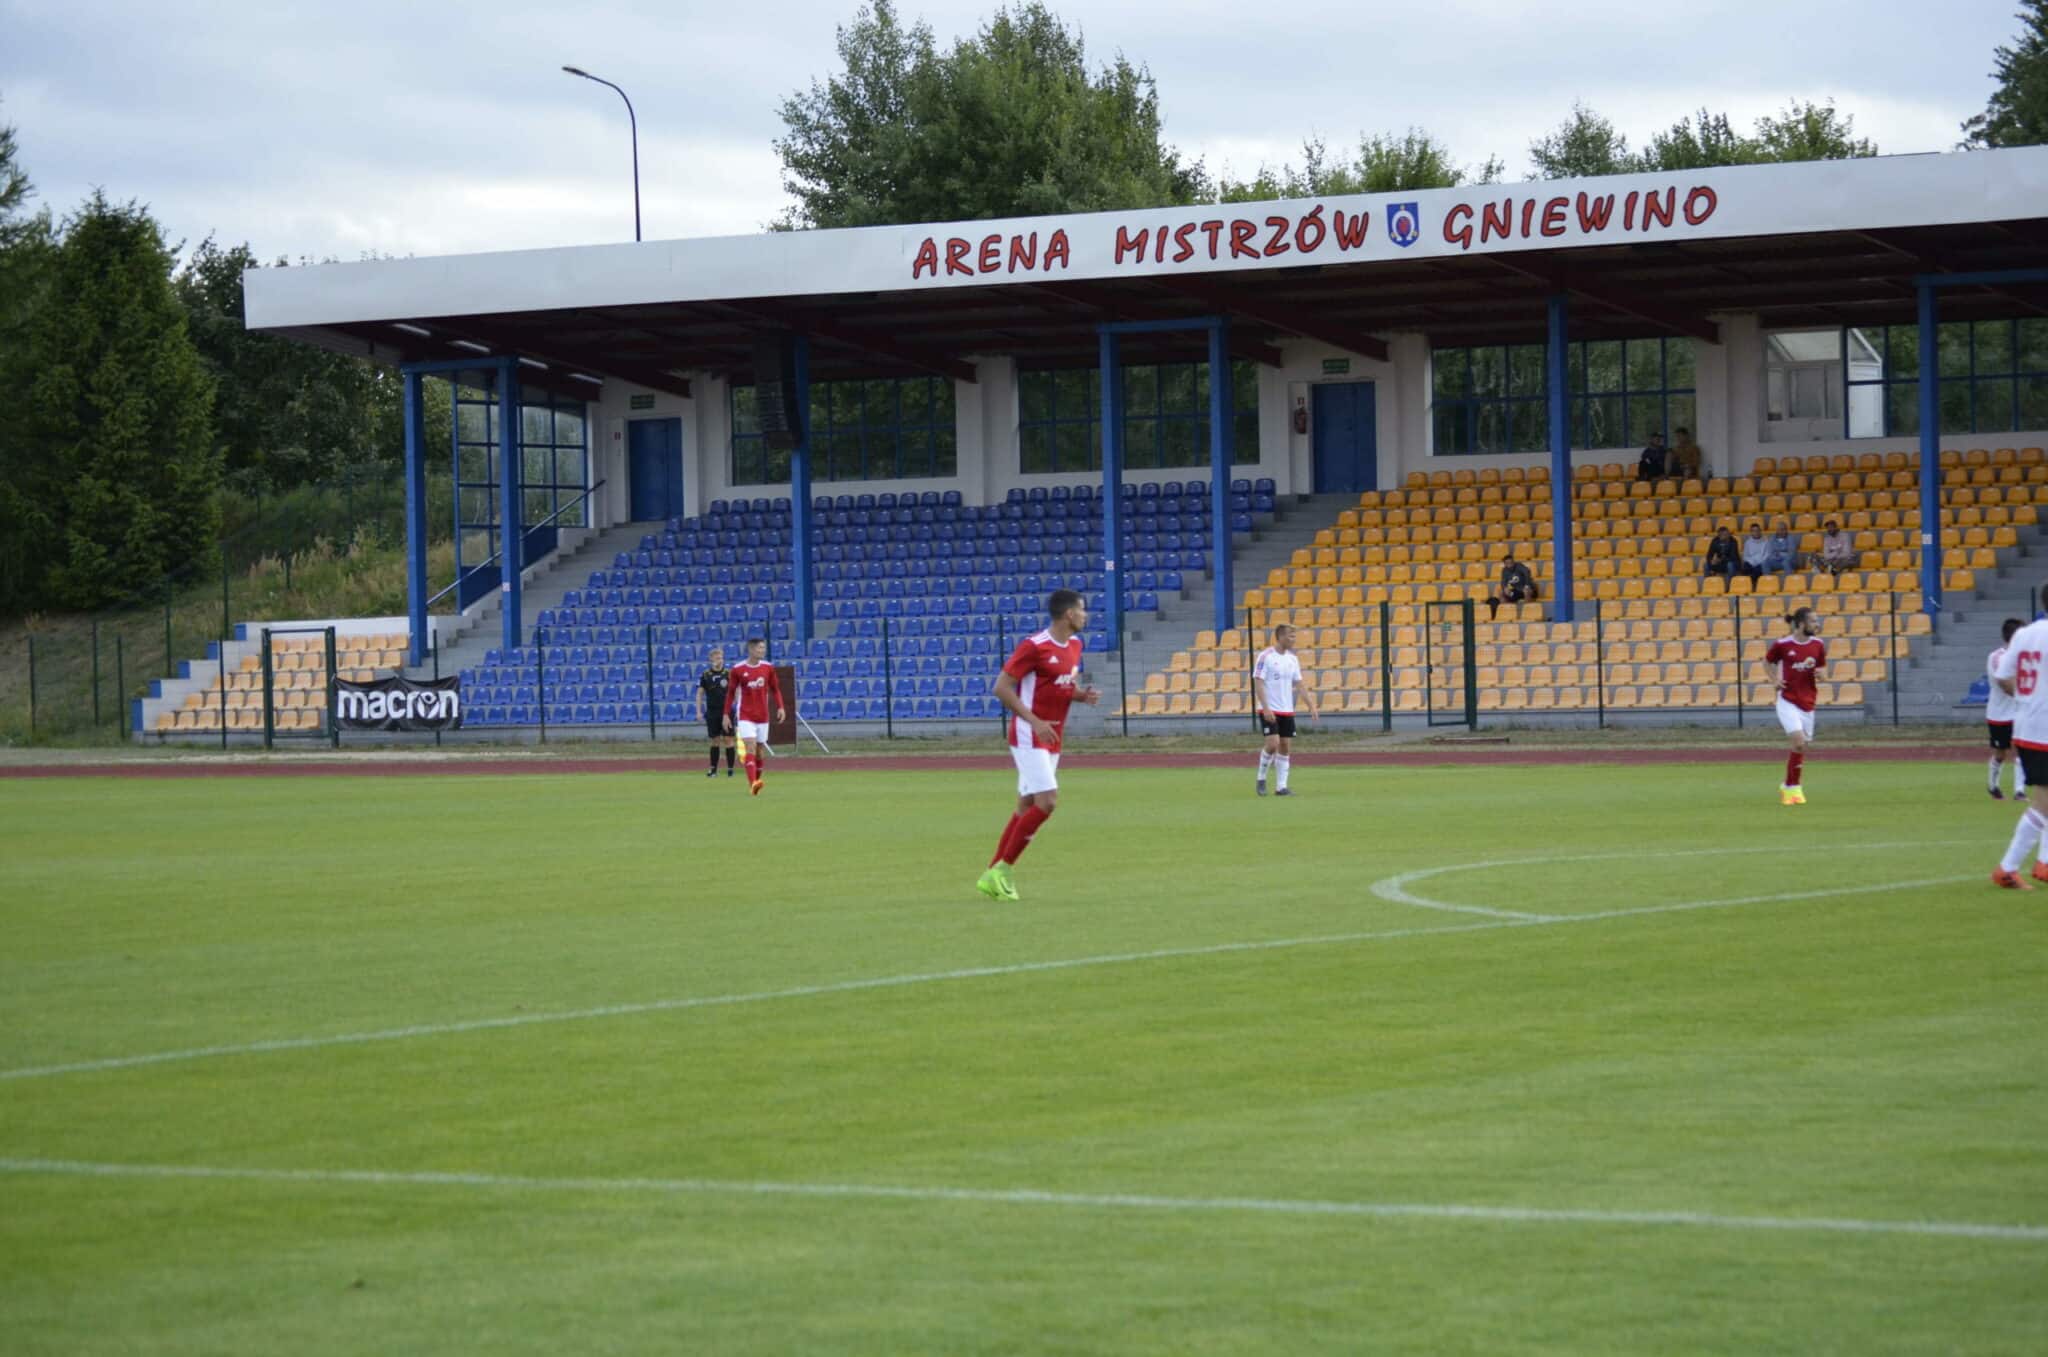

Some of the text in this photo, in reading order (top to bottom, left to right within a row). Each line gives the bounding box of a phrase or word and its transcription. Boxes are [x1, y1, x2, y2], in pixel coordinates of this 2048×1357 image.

[913, 186, 1718, 279] ARENA MISTRZÓW GNIEWINO
[337, 690, 459, 719] macron
